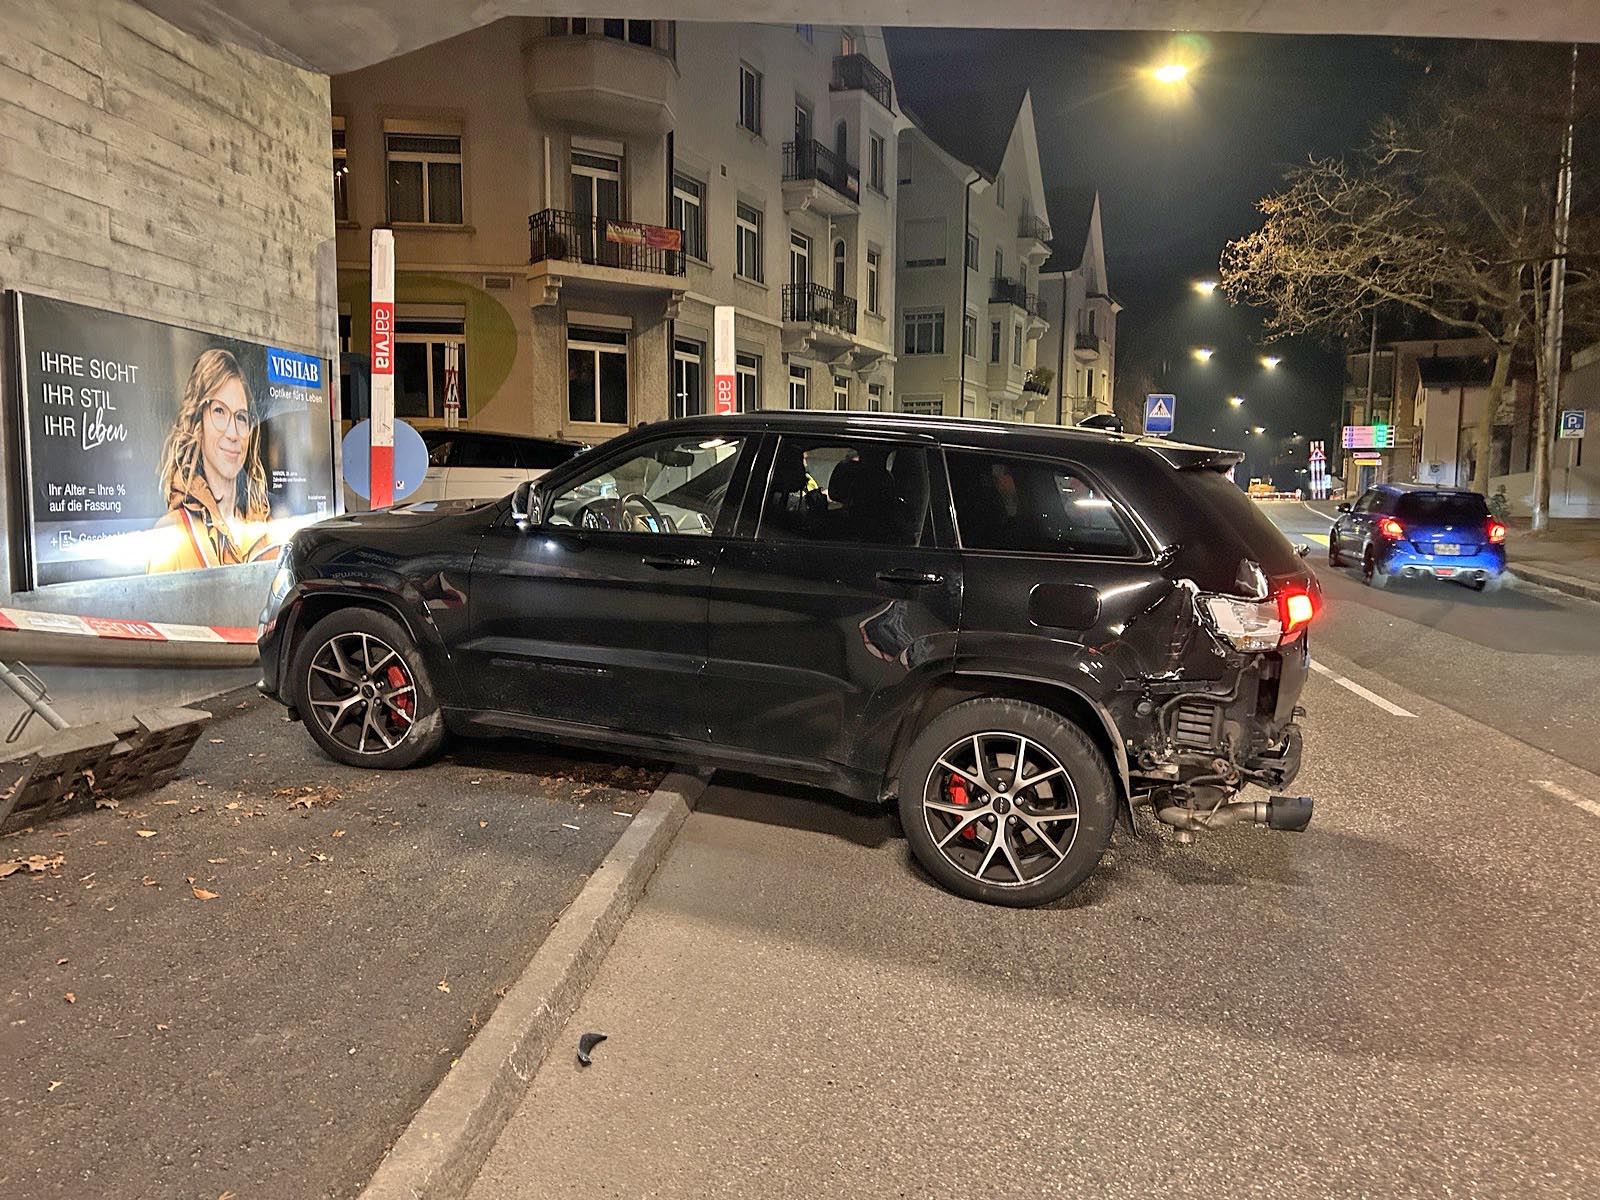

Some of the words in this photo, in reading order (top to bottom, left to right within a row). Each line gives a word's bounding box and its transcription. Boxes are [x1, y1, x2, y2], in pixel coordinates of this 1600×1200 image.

[375, 308, 390, 368] aarvia
[41, 351, 84, 377] IHRE
[89, 358, 139, 384] SICHT
[271, 354, 319, 382] VISILAB
[43, 383, 74, 406] IHR
[80, 387, 116, 410] STIL
[269, 386, 292, 400] Optiker
[44, 415, 76, 437] IHR
[82, 406, 128, 451] Leben
[1568, 416, 1577, 428] P
[48, 483, 62, 496] Ihr
[64, 484, 86, 496] Alter
[97, 484, 114, 496] Ihre
[117, 484, 126, 496] %
[49, 499, 66, 512] auf
[67, 499, 82, 512] die
[84, 500, 121, 513] Fassung
